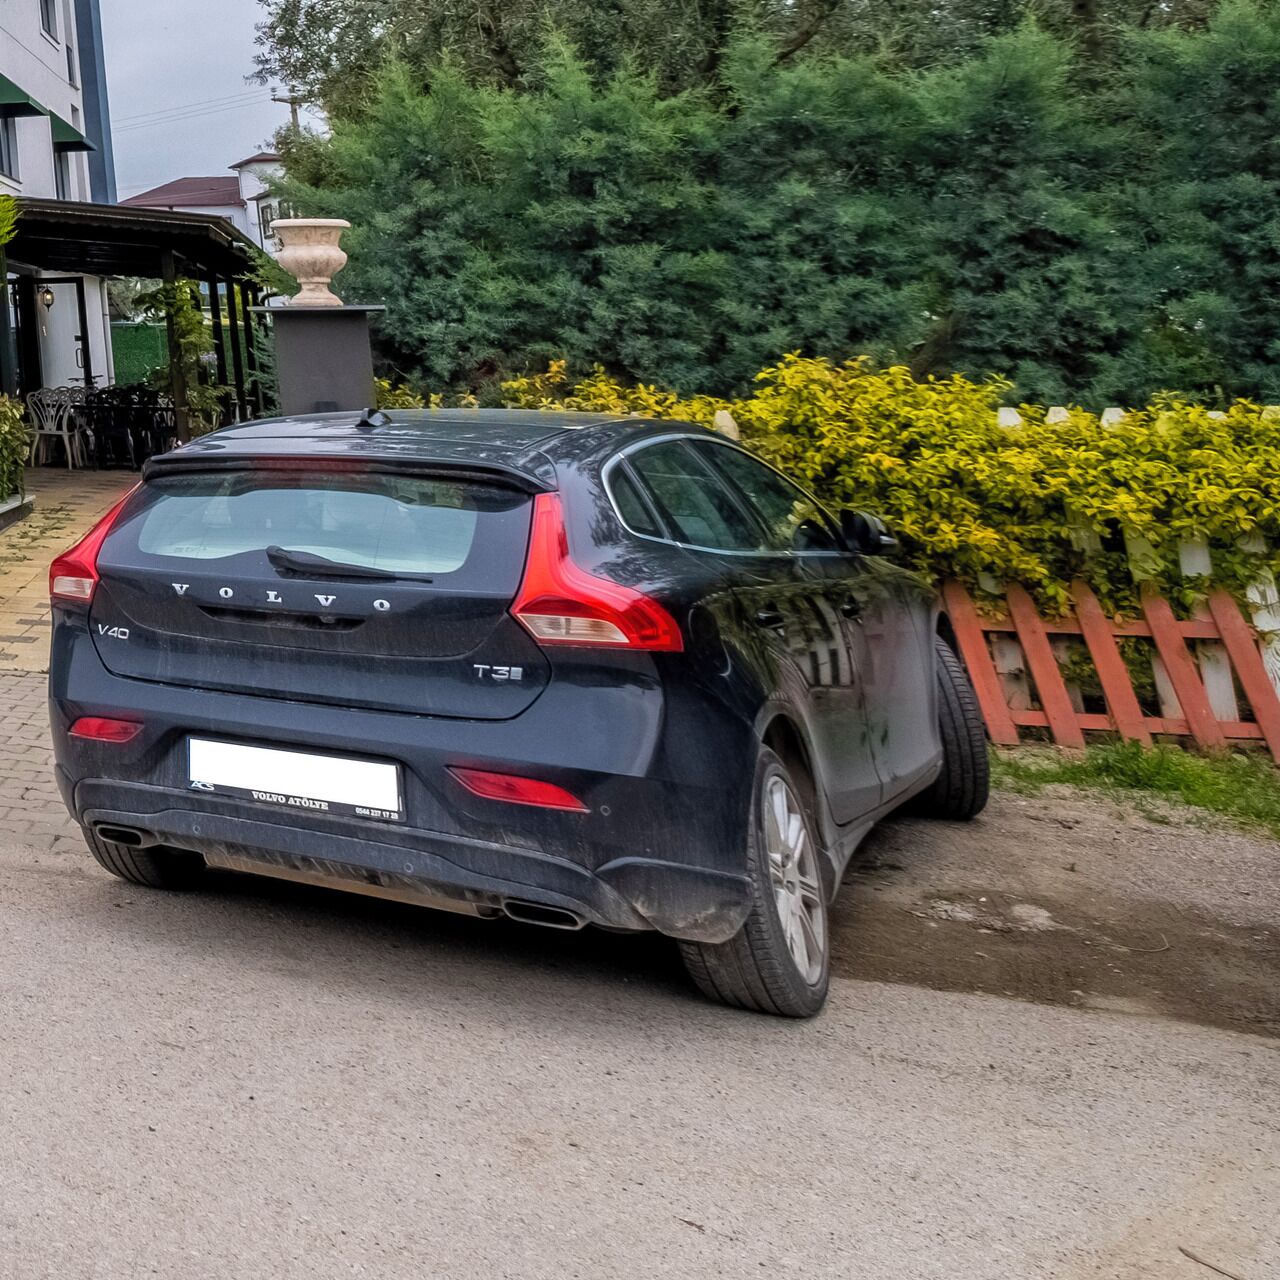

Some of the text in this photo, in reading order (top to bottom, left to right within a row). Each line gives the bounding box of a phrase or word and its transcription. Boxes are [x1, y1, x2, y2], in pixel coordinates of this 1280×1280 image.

[171, 583, 391, 612] VOLVO
[98, 624, 129, 639] V40
[251, 790, 329, 810] VOLVO ATÖLYE
